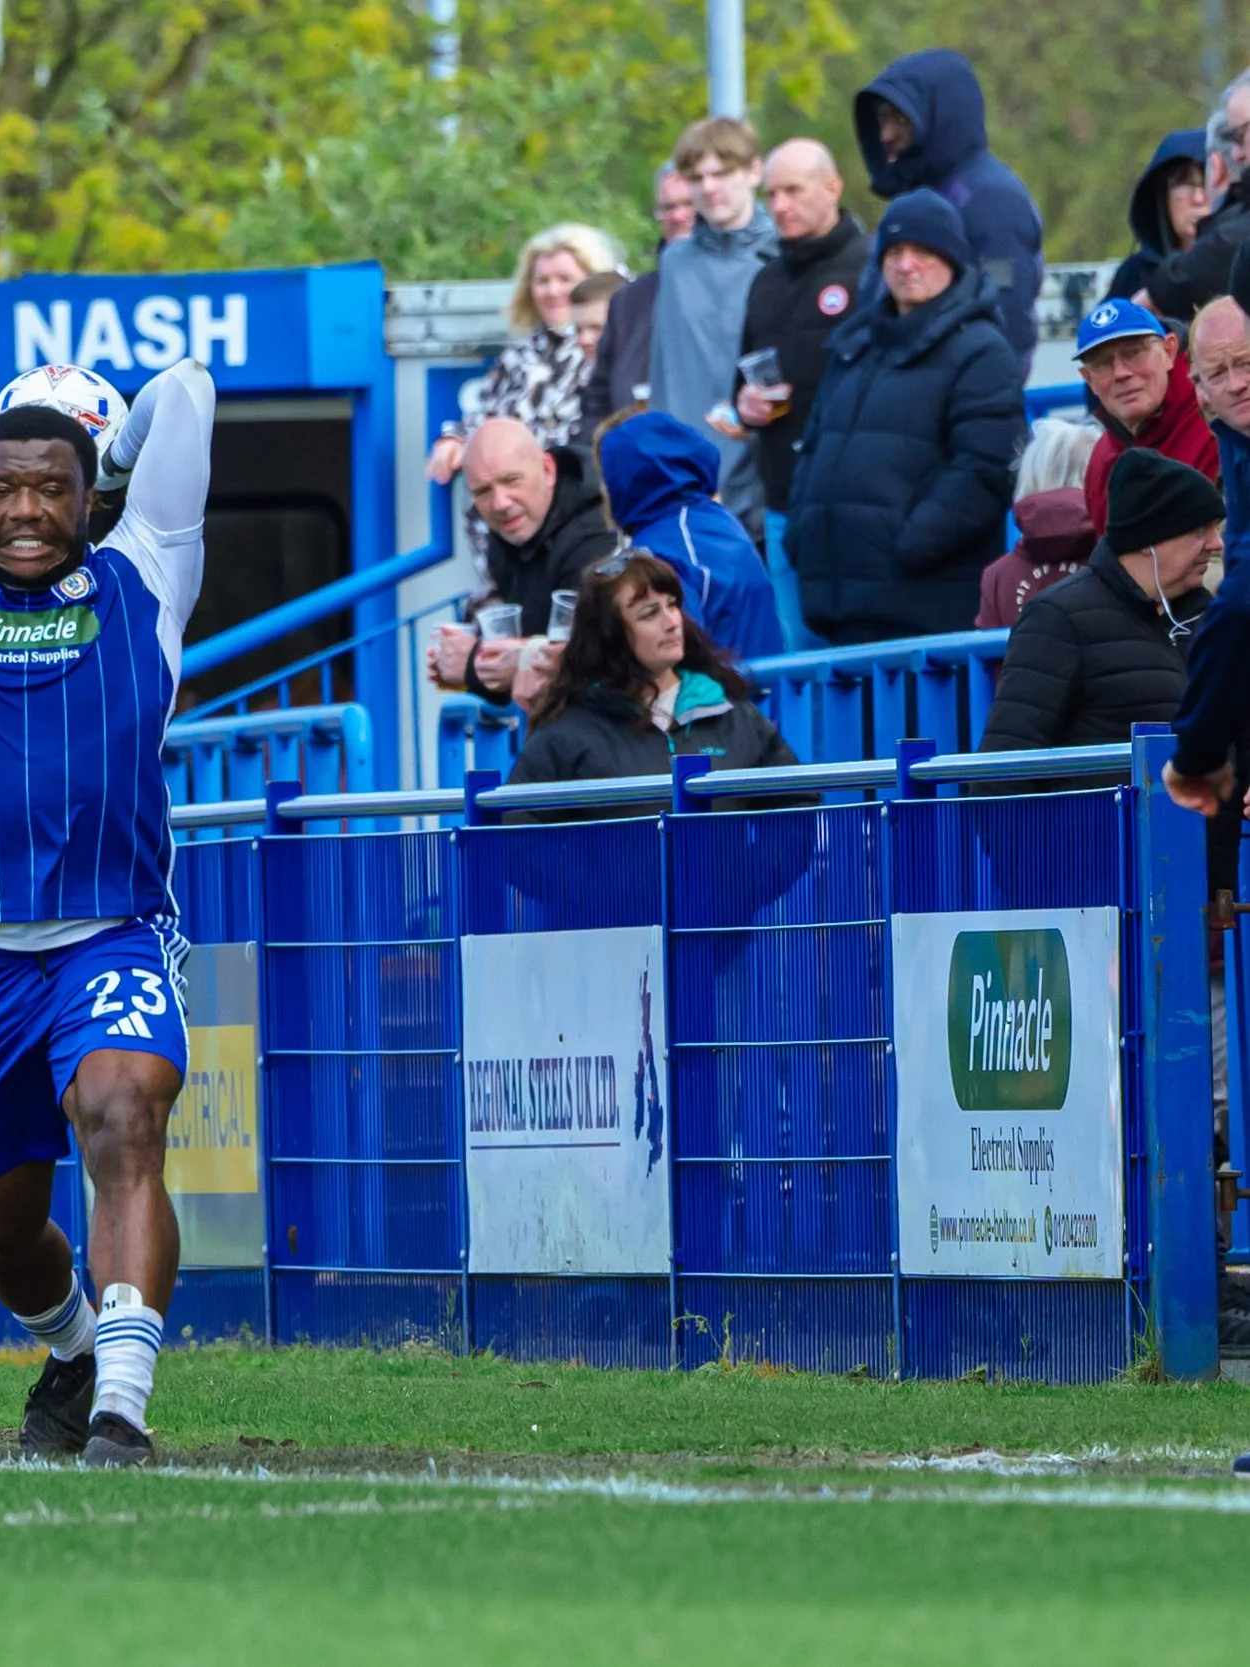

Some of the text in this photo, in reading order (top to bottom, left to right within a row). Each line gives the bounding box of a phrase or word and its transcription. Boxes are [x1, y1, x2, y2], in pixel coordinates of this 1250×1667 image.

[13, 294, 247, 373] NASH
[31, 649, 80, 664] Supplies
[86, 968, 167, 1018] 23
[969, 968, 1053, 1072] Pinnacle
[166, 1070, 250, 1149] ECTRICAL
[468, 1055, 620, 1132] REGIONAL STEELS UK LTD.
[971, 1125, 1055, 1185] Electrical Supplies
